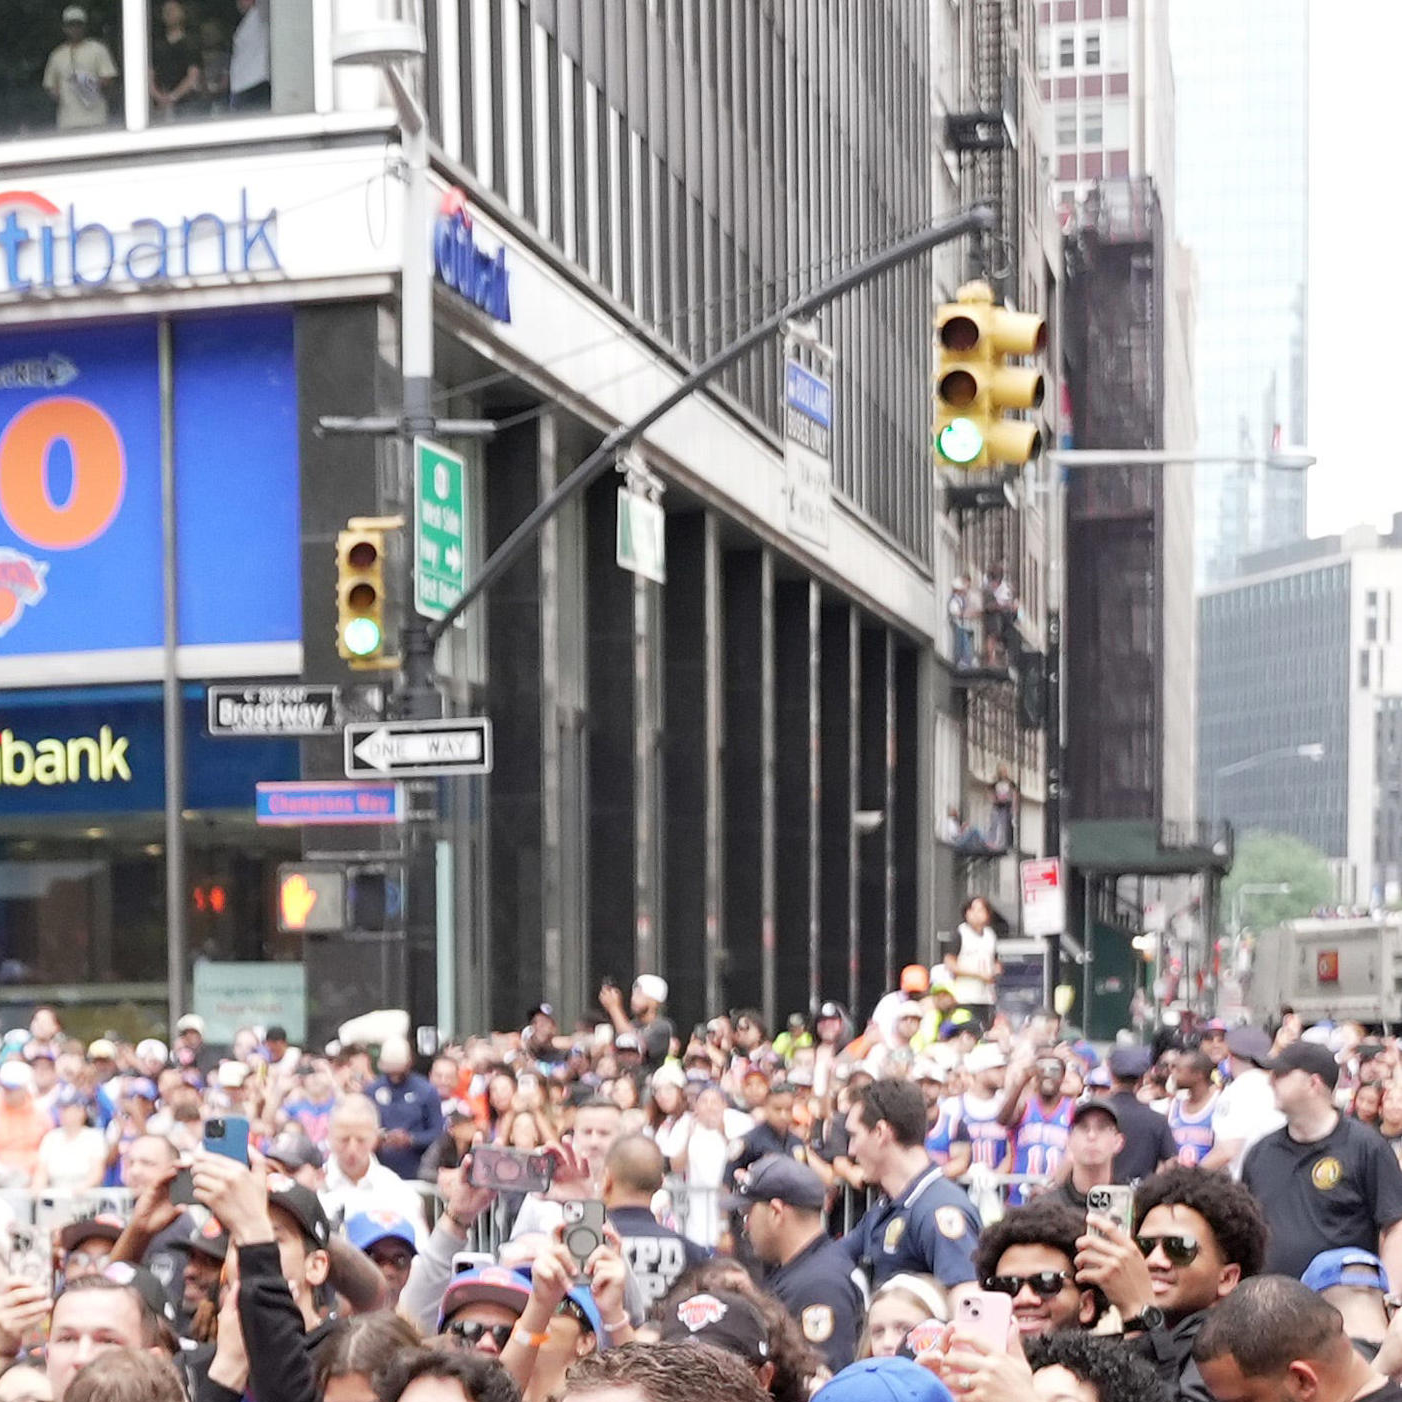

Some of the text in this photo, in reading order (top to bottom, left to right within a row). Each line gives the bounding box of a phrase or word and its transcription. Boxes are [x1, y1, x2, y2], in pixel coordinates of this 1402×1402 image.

[218, 698, 328, 728] Broadway
[369, 735, 467, 760] ONE WAY
